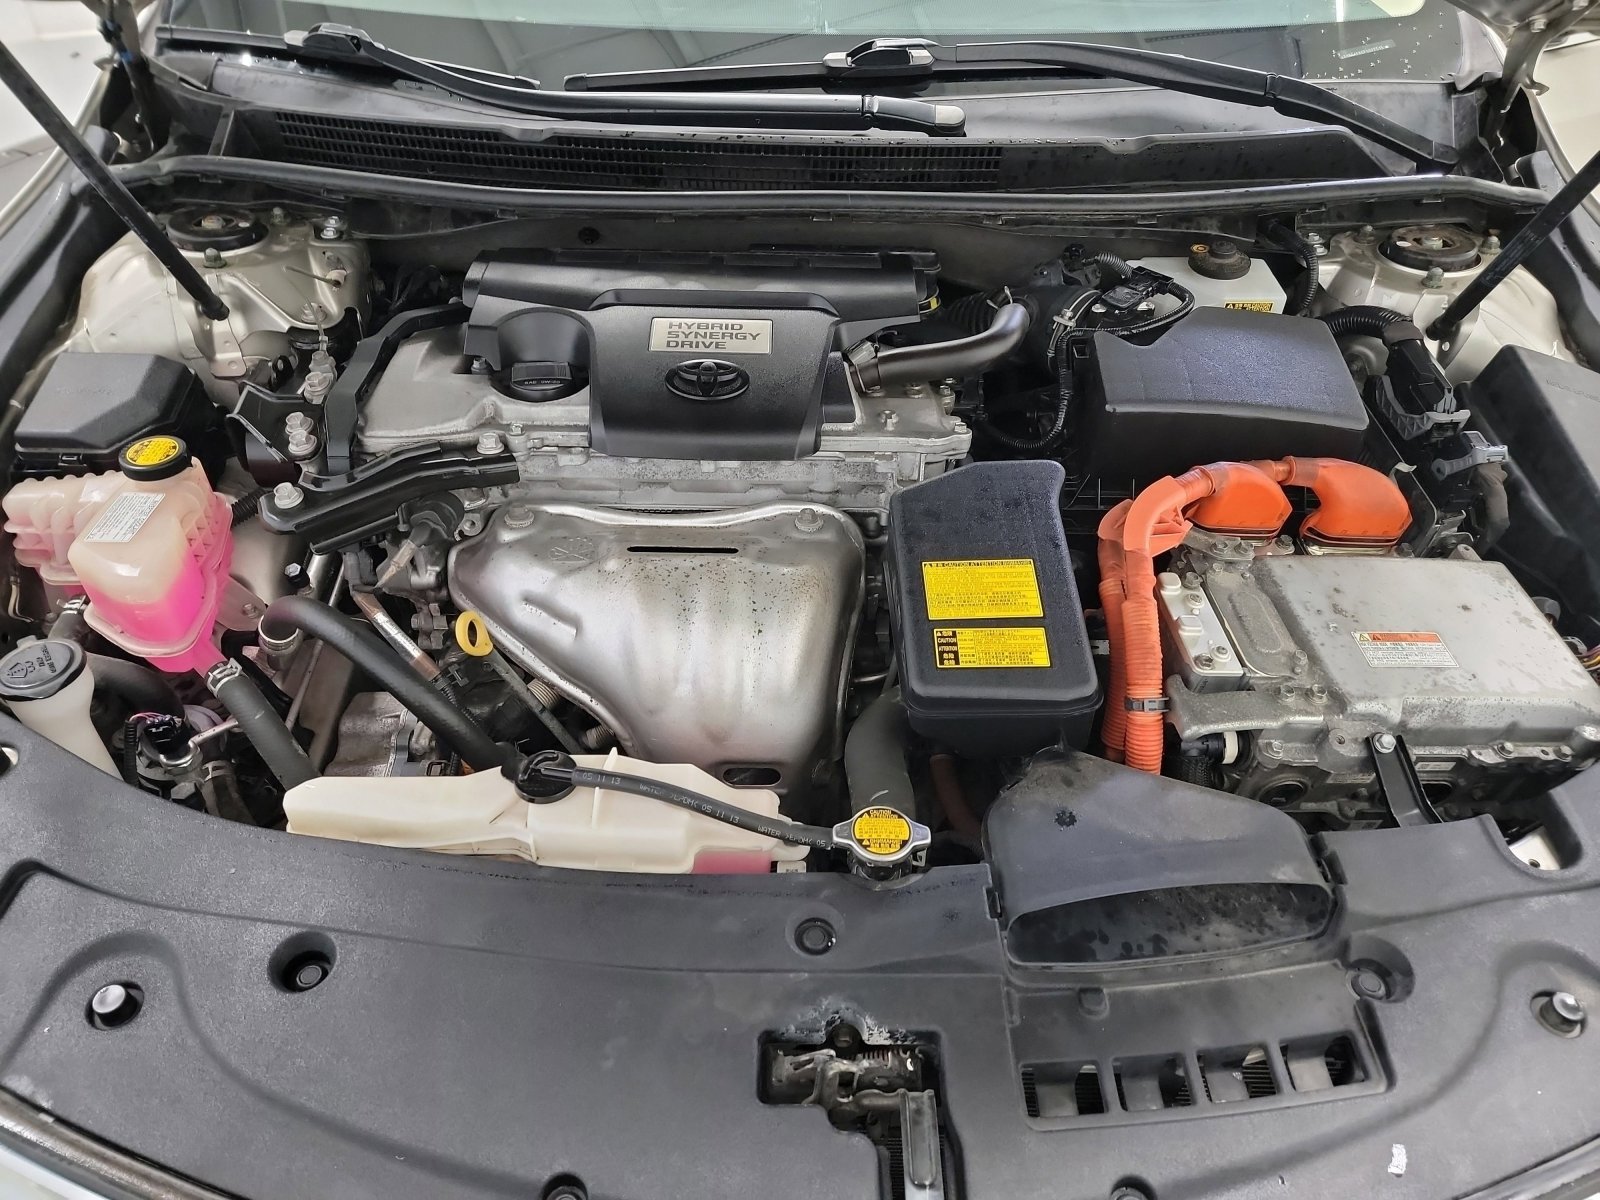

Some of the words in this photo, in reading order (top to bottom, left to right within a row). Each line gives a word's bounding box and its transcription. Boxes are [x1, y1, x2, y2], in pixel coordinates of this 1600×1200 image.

[668, 322, 744, 331] HYBRID
[667, 331, 761, 341] SYNERGY
[666, 340, 727, 350] DRIVE
[583, 772, 593, 780] 05
[611, 776, 621, 785] 13
[701, 803, 713, 813] 05
[729, 814, 740, 824] 13
[757, 824, 781, 838] WATER
[816, 839, 826, 847] 05
